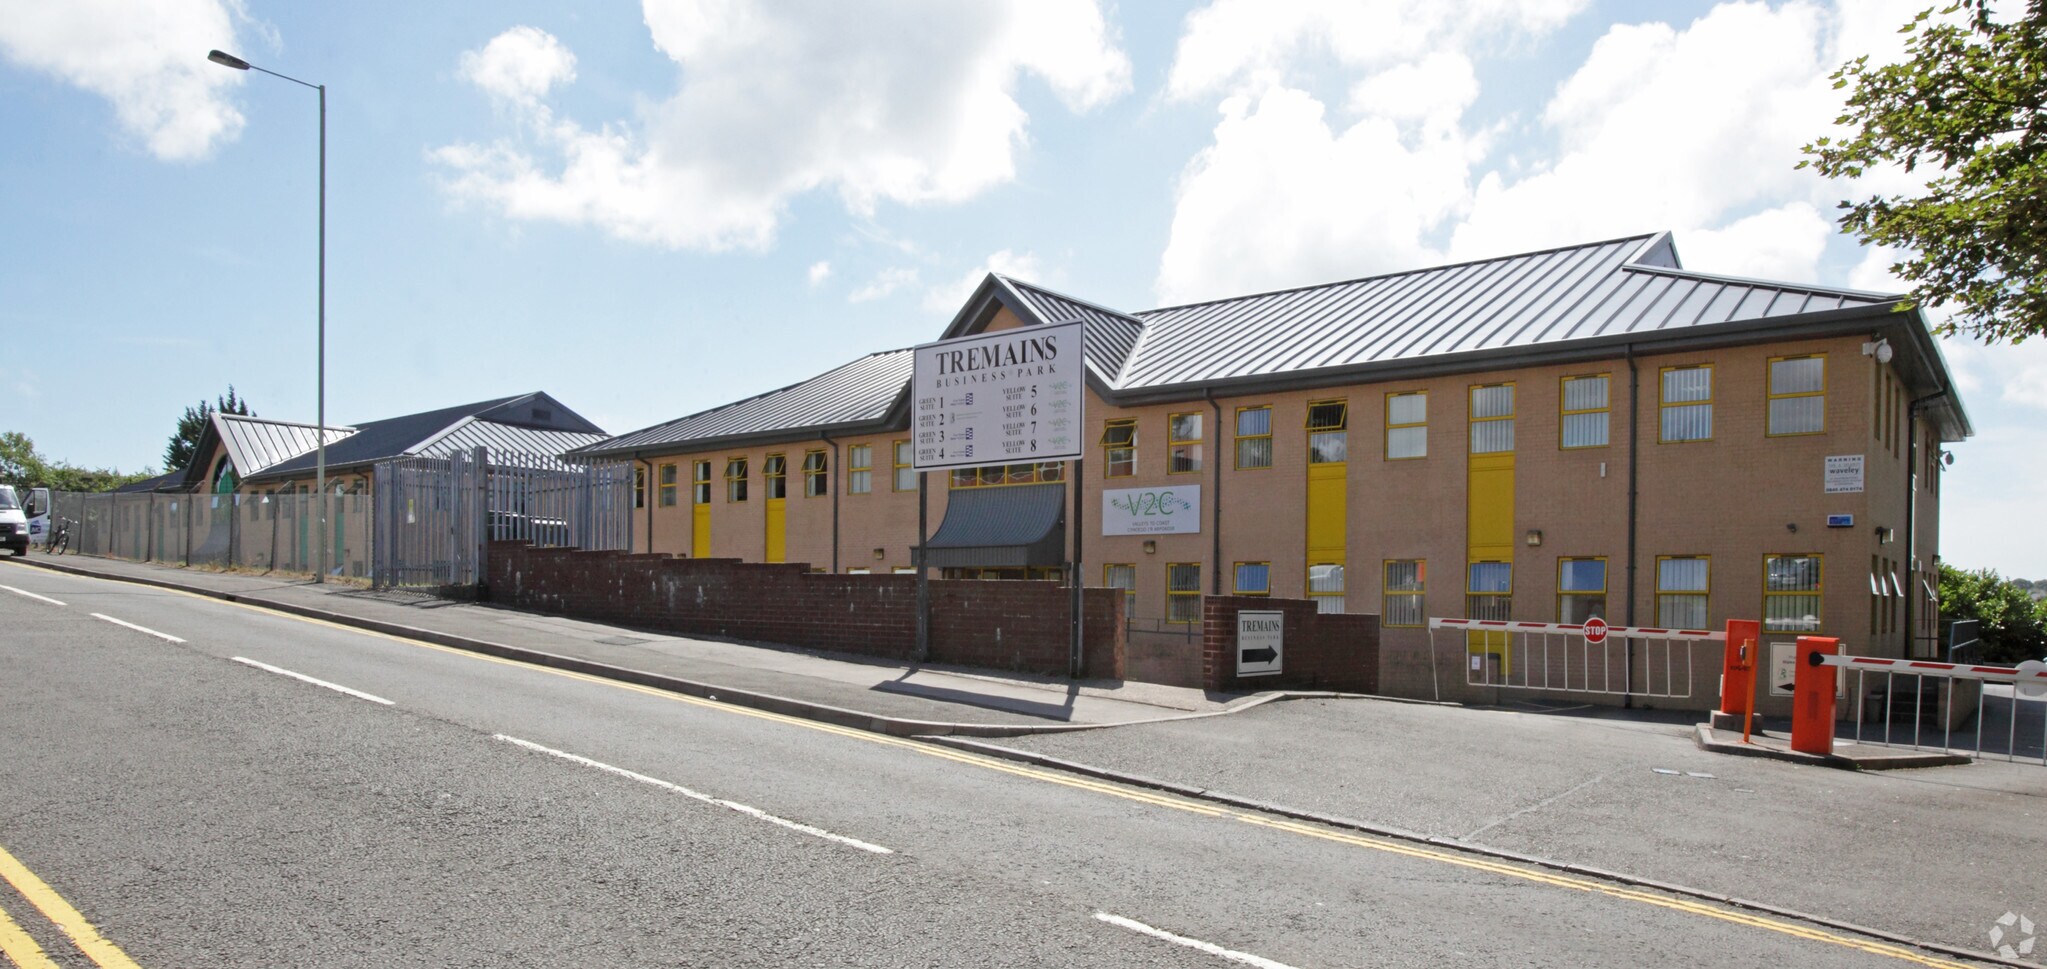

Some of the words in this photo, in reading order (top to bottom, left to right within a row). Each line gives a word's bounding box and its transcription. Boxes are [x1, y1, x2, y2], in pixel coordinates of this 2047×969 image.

[936, 335, 1057, 375] TREMAINS
[936, 371, 1006, 388] BUSINESS
[1018, 363, 1056, 378] PARK
[1003, 386, 1026, 394] YELLOW
[1031, 385, 1037, 398] 5
[940, 397, 944, 409] 1
[1003, 404, 1025, 412] YELLOW
[1031, 403, 1037, 416] 6
[939, 413, 945, 426] 2
[1002, 422, 1025, 430] YELLOW
[1031, 421, 1037, 433] 7
[939, 430, 945, 443] 3
[1002, 440, 1025, 448] YELLOW
[1030, 439, 1037, 452] 8
[939, 447, 945, 459] 4
[1127, 491, 1174, 517] V2C
[1242, 620, 1280, 632] TREMAINS
[1585, 626, 1606, 636] STOP
